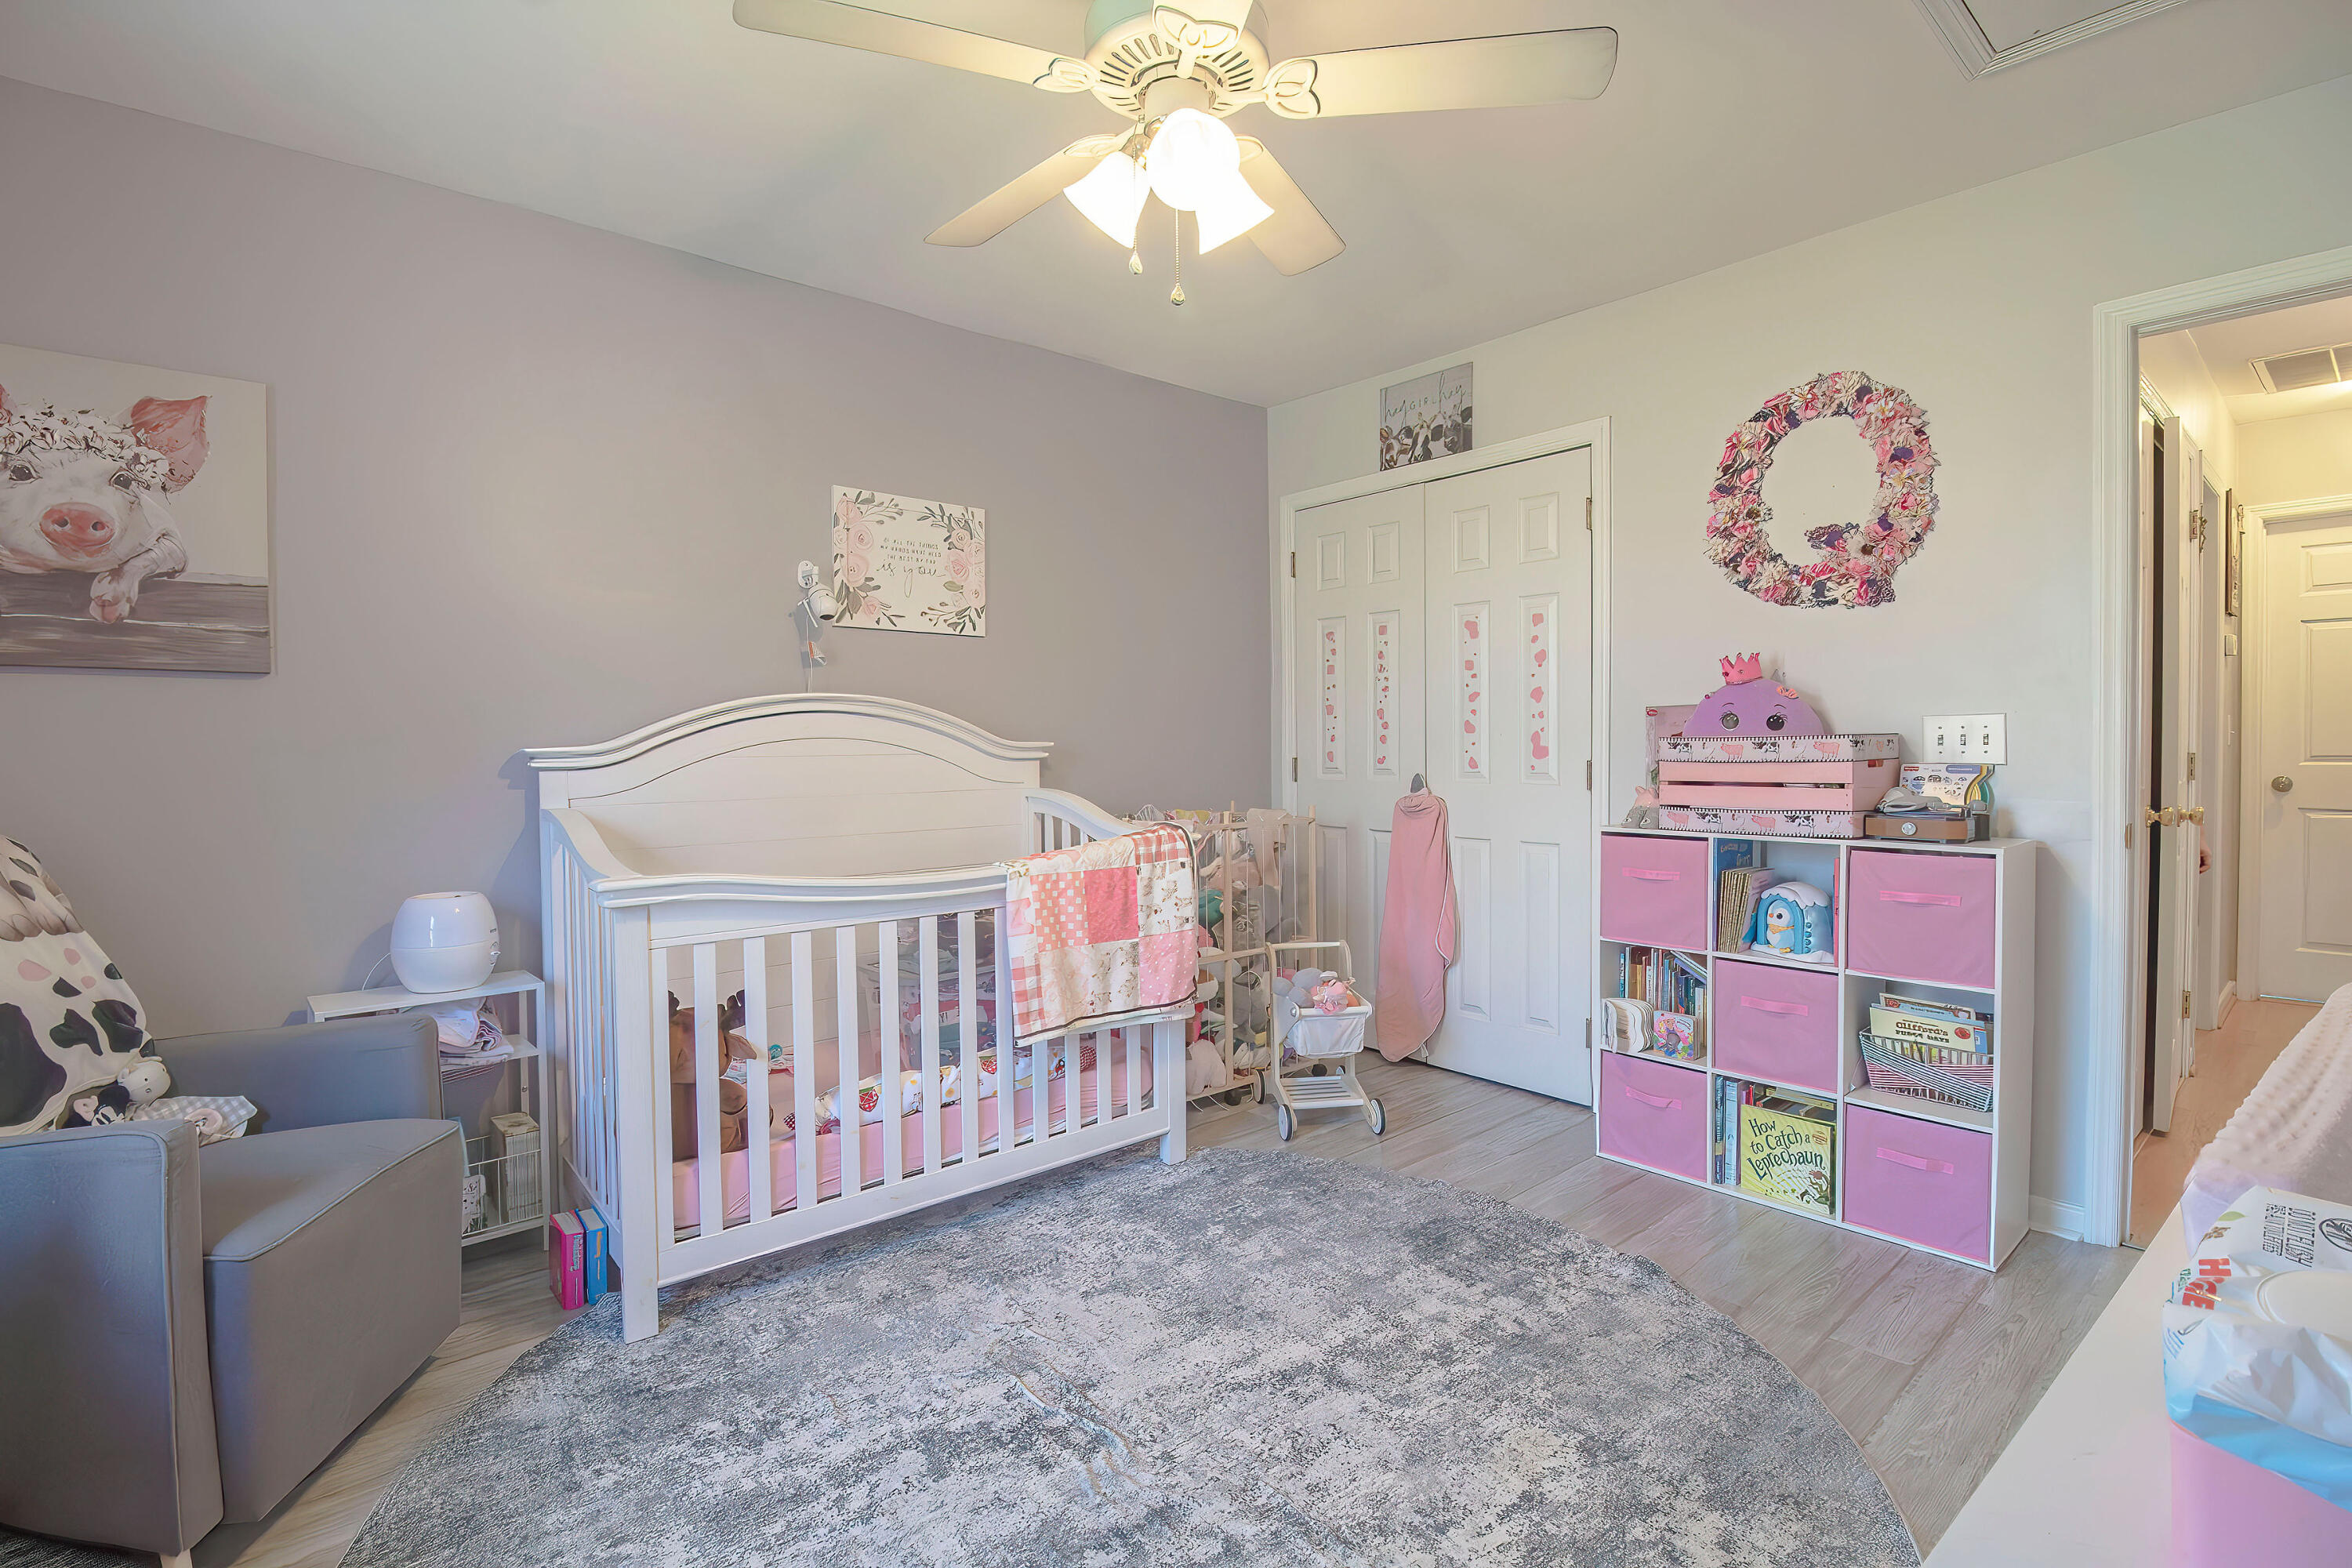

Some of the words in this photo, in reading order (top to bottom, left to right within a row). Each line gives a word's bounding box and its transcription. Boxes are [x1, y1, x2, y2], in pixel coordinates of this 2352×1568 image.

[1704, 372, 1940, 609] Q
[1748, 1118, 1777, 1138] How
[1750, 1140, 1764, 1155] to
[1765, 1125, 1802, 1149] Catch
[1805, 1134, 1810, 1144] a
[1747, 1148, 1826, 1181] Leprechaun
